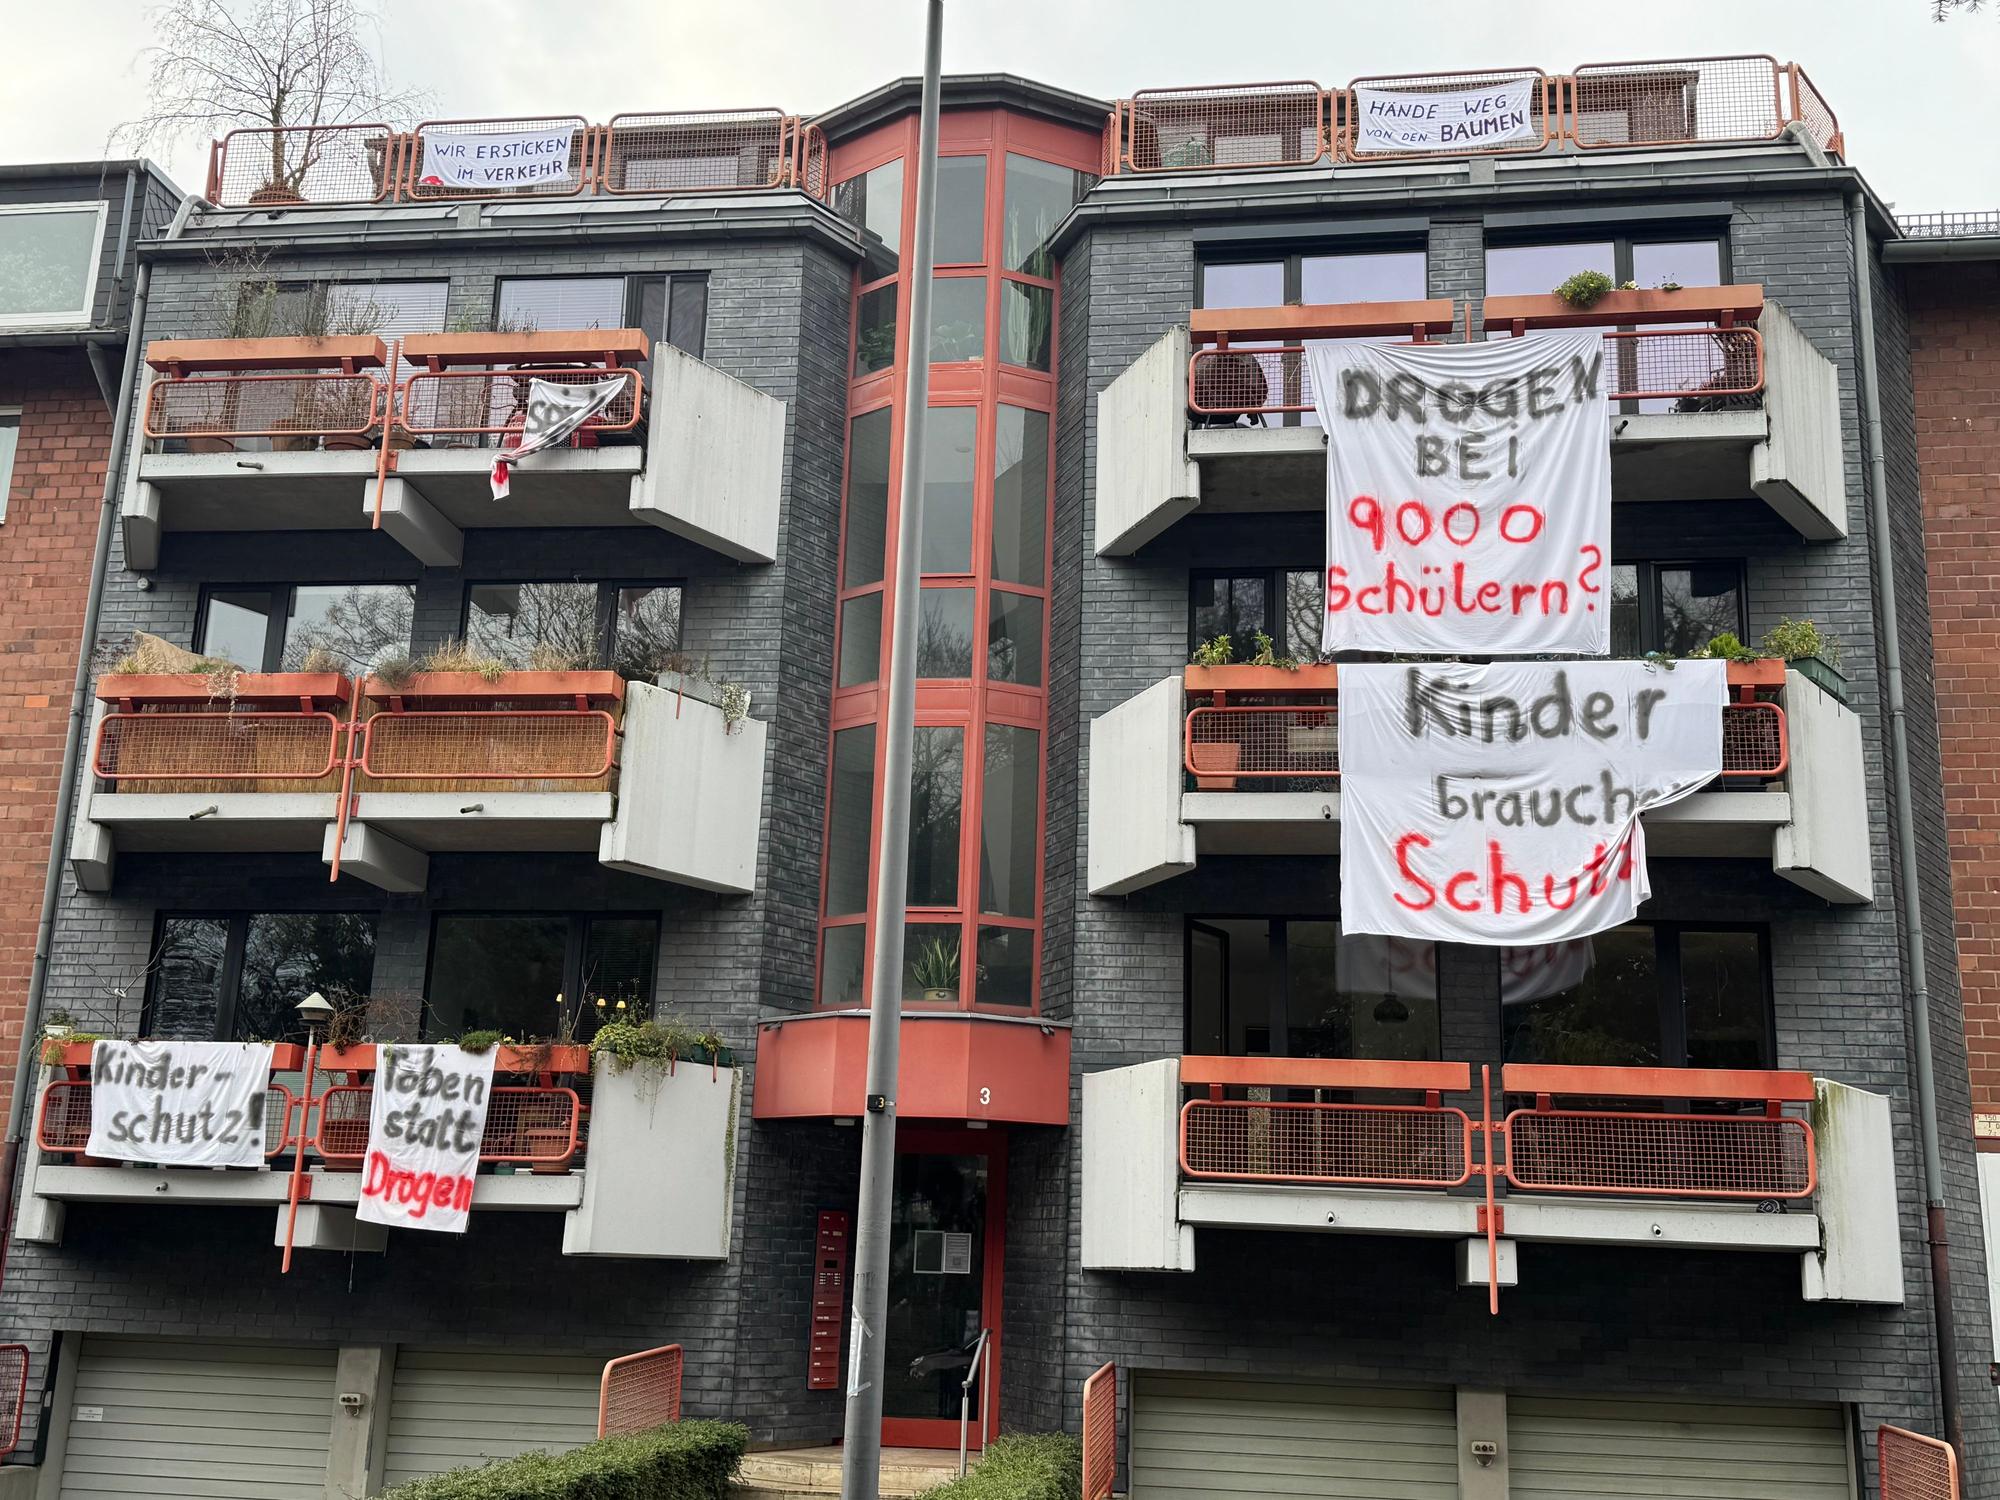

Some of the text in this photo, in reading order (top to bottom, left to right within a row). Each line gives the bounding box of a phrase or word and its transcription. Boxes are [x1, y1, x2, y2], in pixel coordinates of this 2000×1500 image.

[1366, 110, 1524, 142] VON DEN BÄUMEN
[1369, 94, 1506, 119] HÄNDE WEG
[484, 160, 563, 181] VERKEHR
[1340, 350, 1603, 424] DROGEN
[1349, 495, 1545, 552] 9000
[1328, 544, 1602, 617] Schülern?
[1403, 666, 1667, 744] Kinder
[383, 1047, 484, 1106] Toben
[980, 1087, 991, 1105] 3
[383, 1102, 476, 1153] statt
[362, 1151, 474, 1219] Drogen
